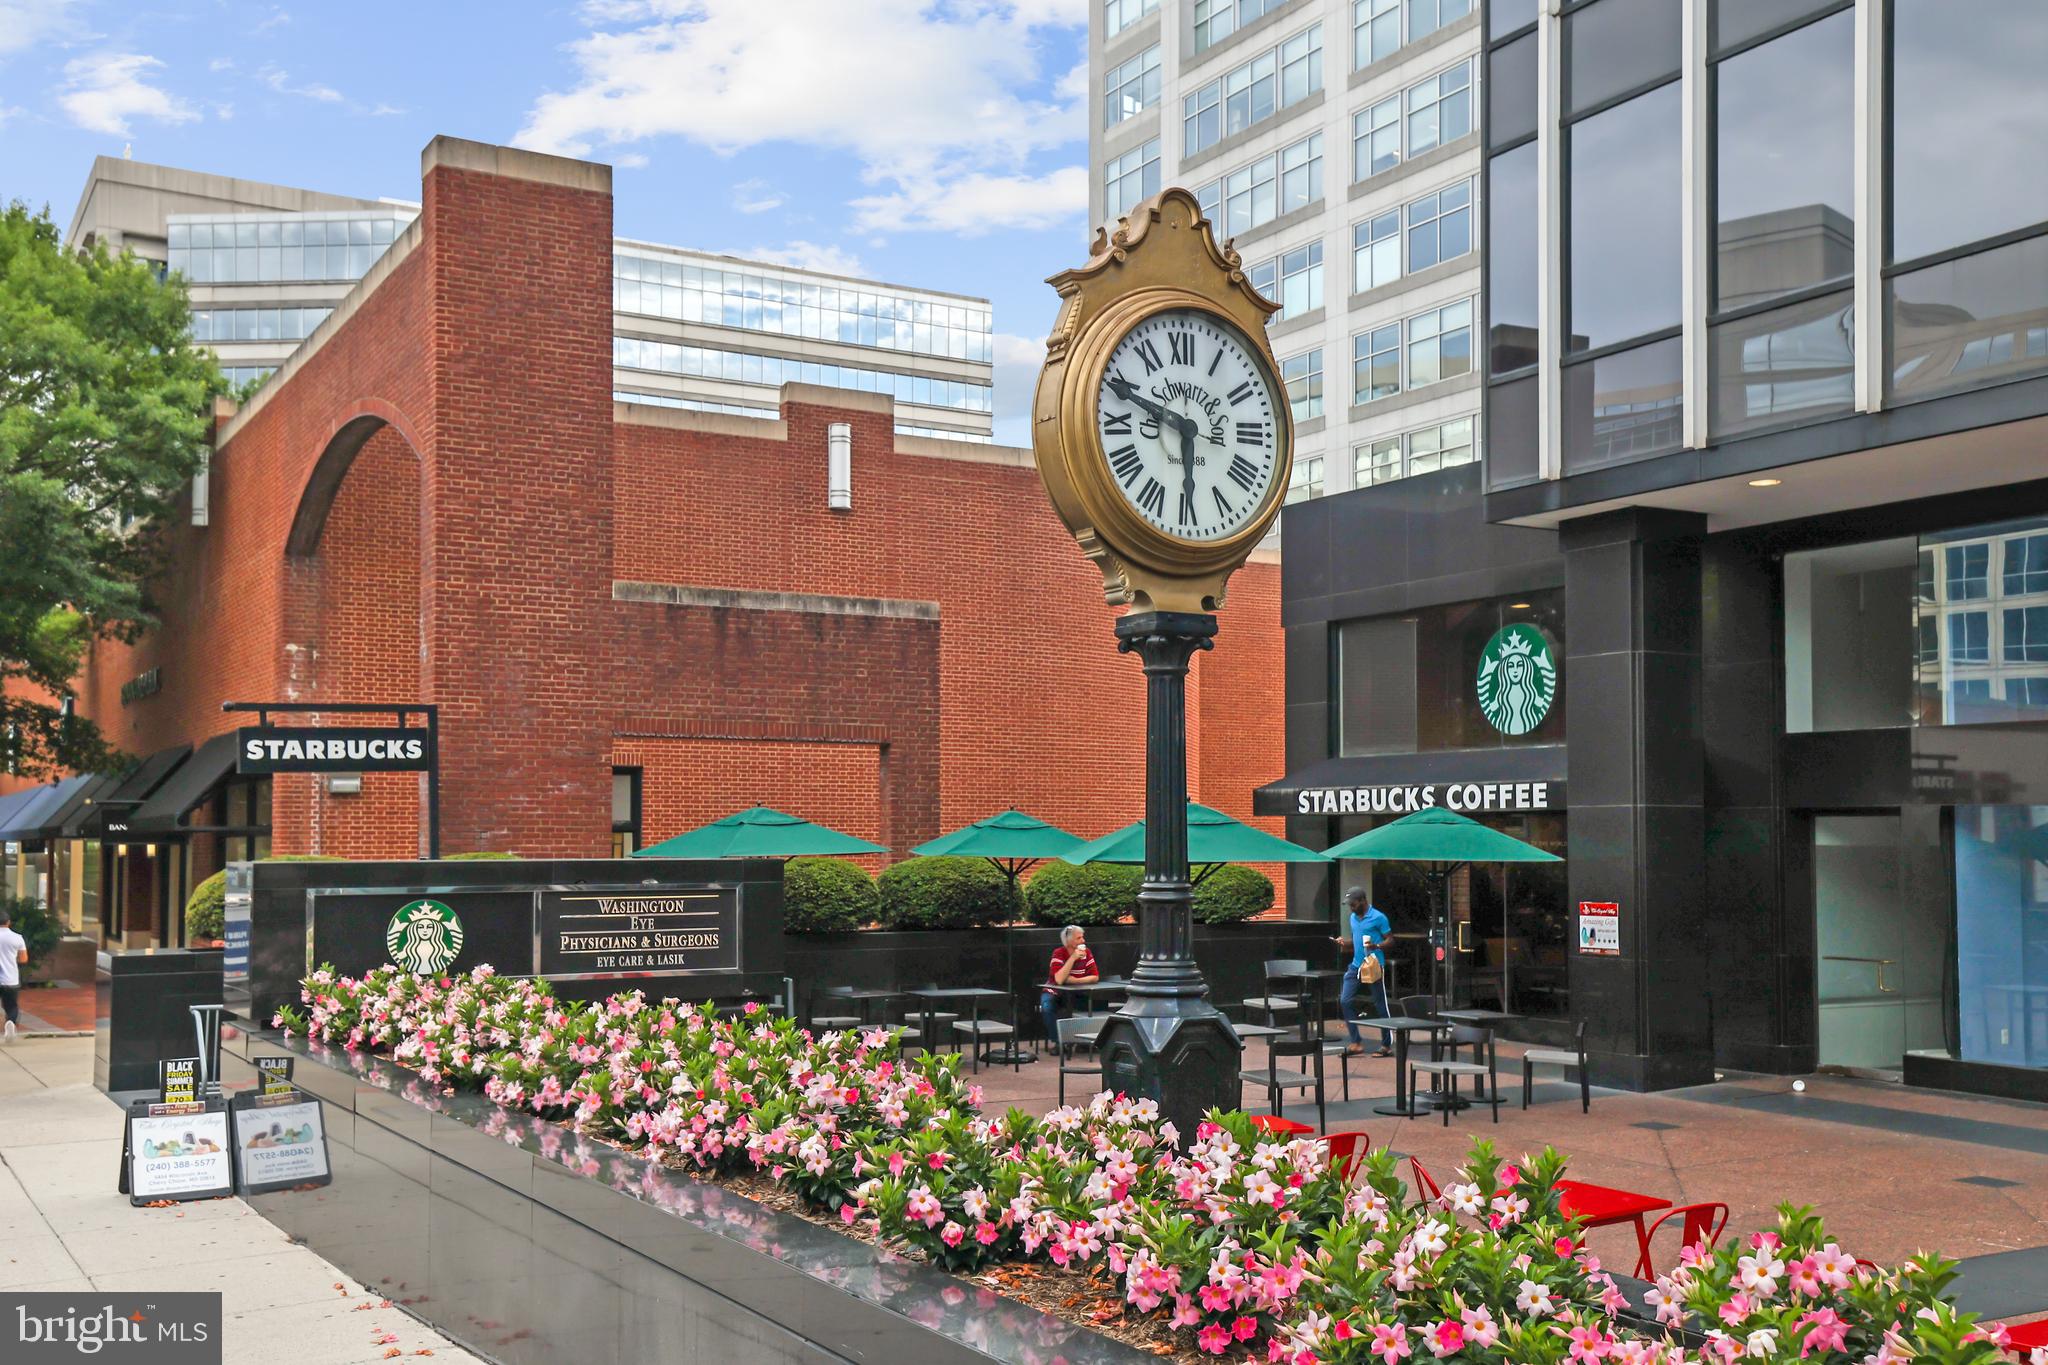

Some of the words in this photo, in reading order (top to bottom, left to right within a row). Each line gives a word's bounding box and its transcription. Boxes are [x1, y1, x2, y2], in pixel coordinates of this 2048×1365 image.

[1168, 331, 1195, 367] XII
[1151, 376, 1209, 407] Schwartz
[1204, 397, 1221, 417] &
[1209, 414, 1229, 445] Son
[1167, 454, 1183, 465] Sinc
[246, 739, 423, 760] STARBUCKS
[1298, 786, 1436, 813] STARBUCKS
[1446, 782, 1548, 810] COFFEE
[598, 899, 685, 914] WASHINGTON
[630, 916, 655, 930] EYE
[560, 935, 637, 950] PHYSICIANS
[640, 936, 651, 948] &
[654, 933, 719, 948] SURGEONS
[597, 956, 616, 968] EYE
[619, 955, 643, 967] CARE
[646, 954, 655, 966] &
[657, 953, 685, 966] LASIK
[167, 1061, 194, 1072] BLACK
[166, 1077, 194, 1085] SUMMER
[167, 1084, 193, 1092] SALE
[146, 1161, 171, 1173] (240)
[173, 1158, 216, 1169] 388-5577
